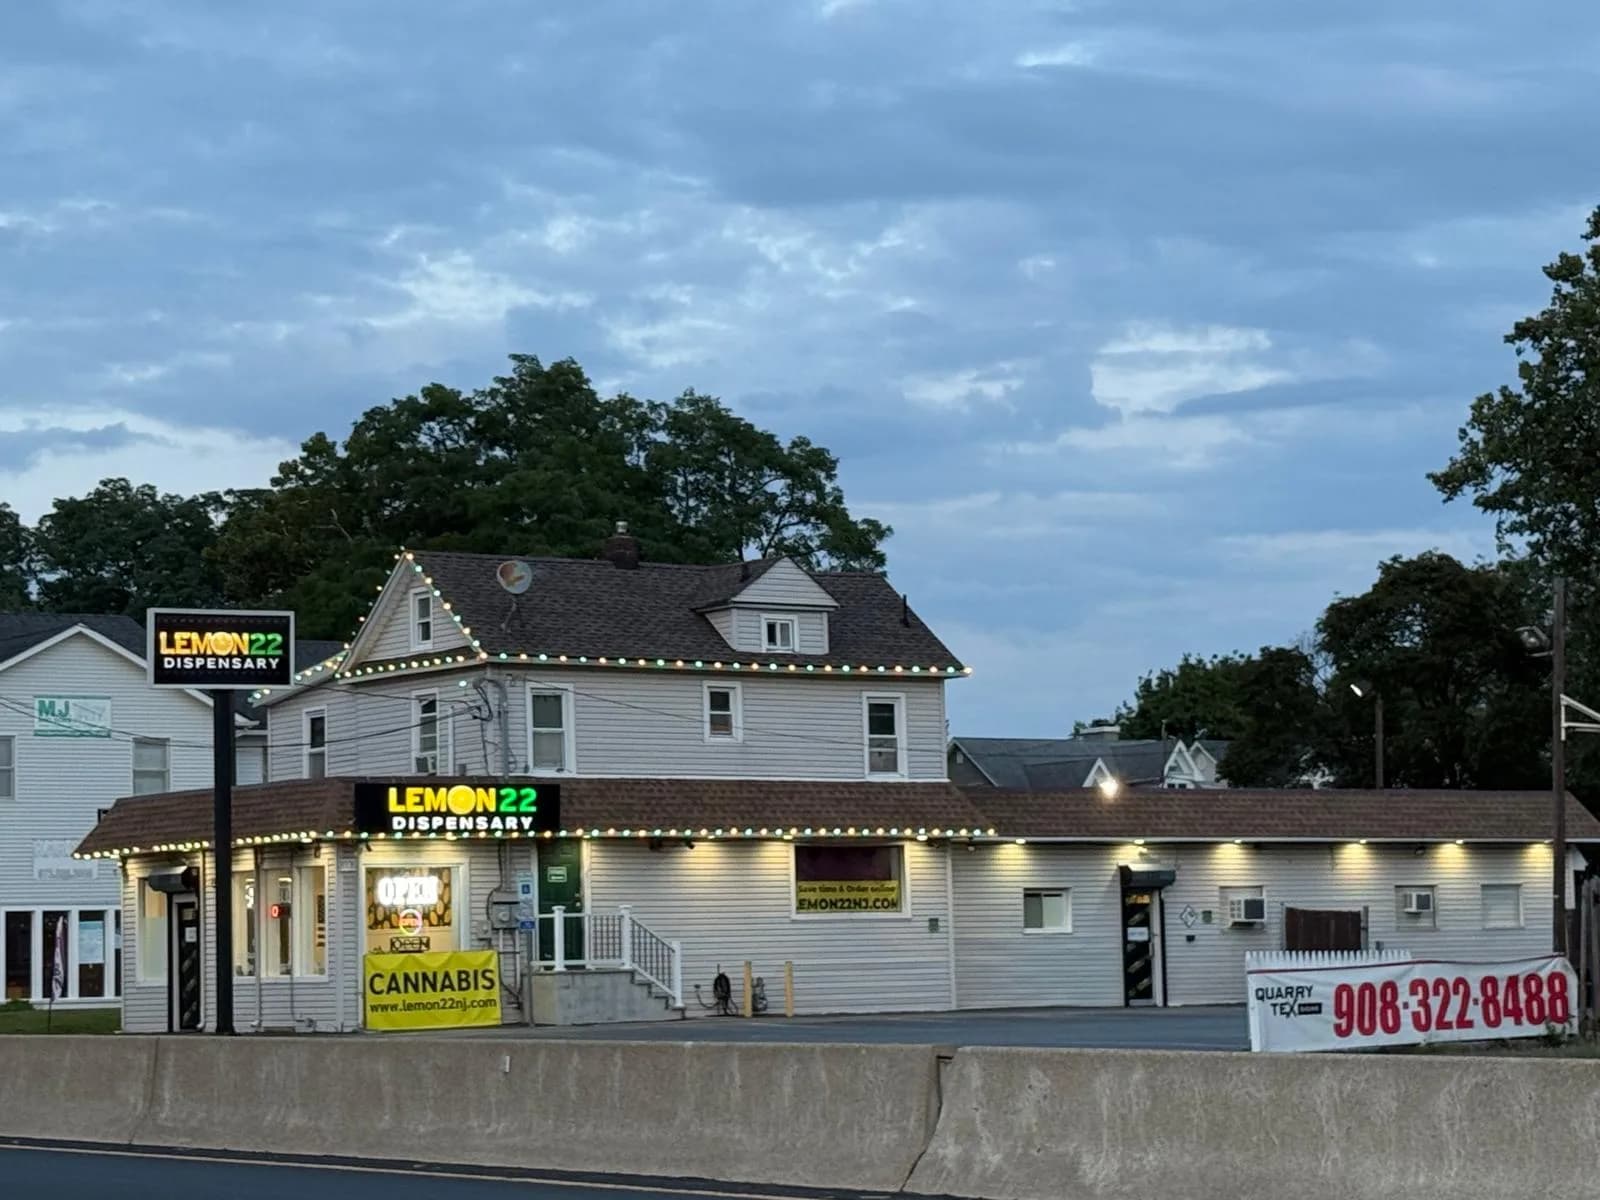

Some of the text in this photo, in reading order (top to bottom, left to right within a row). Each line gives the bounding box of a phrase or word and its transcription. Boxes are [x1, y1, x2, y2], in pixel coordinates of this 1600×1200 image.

[163, 657, 280, 669] DISPENSARY
[392, 816, 533, 830] DISPENSARY
[846, 884, 869, 893] Order
[369, 969, 496, 995] CANNABIS
[1255, 985, 1313, 1003] QUARRY
[369, 998, 498, 1013] www.lemon22nj.com
[1270, 1001, 1298, 1018] TEX
